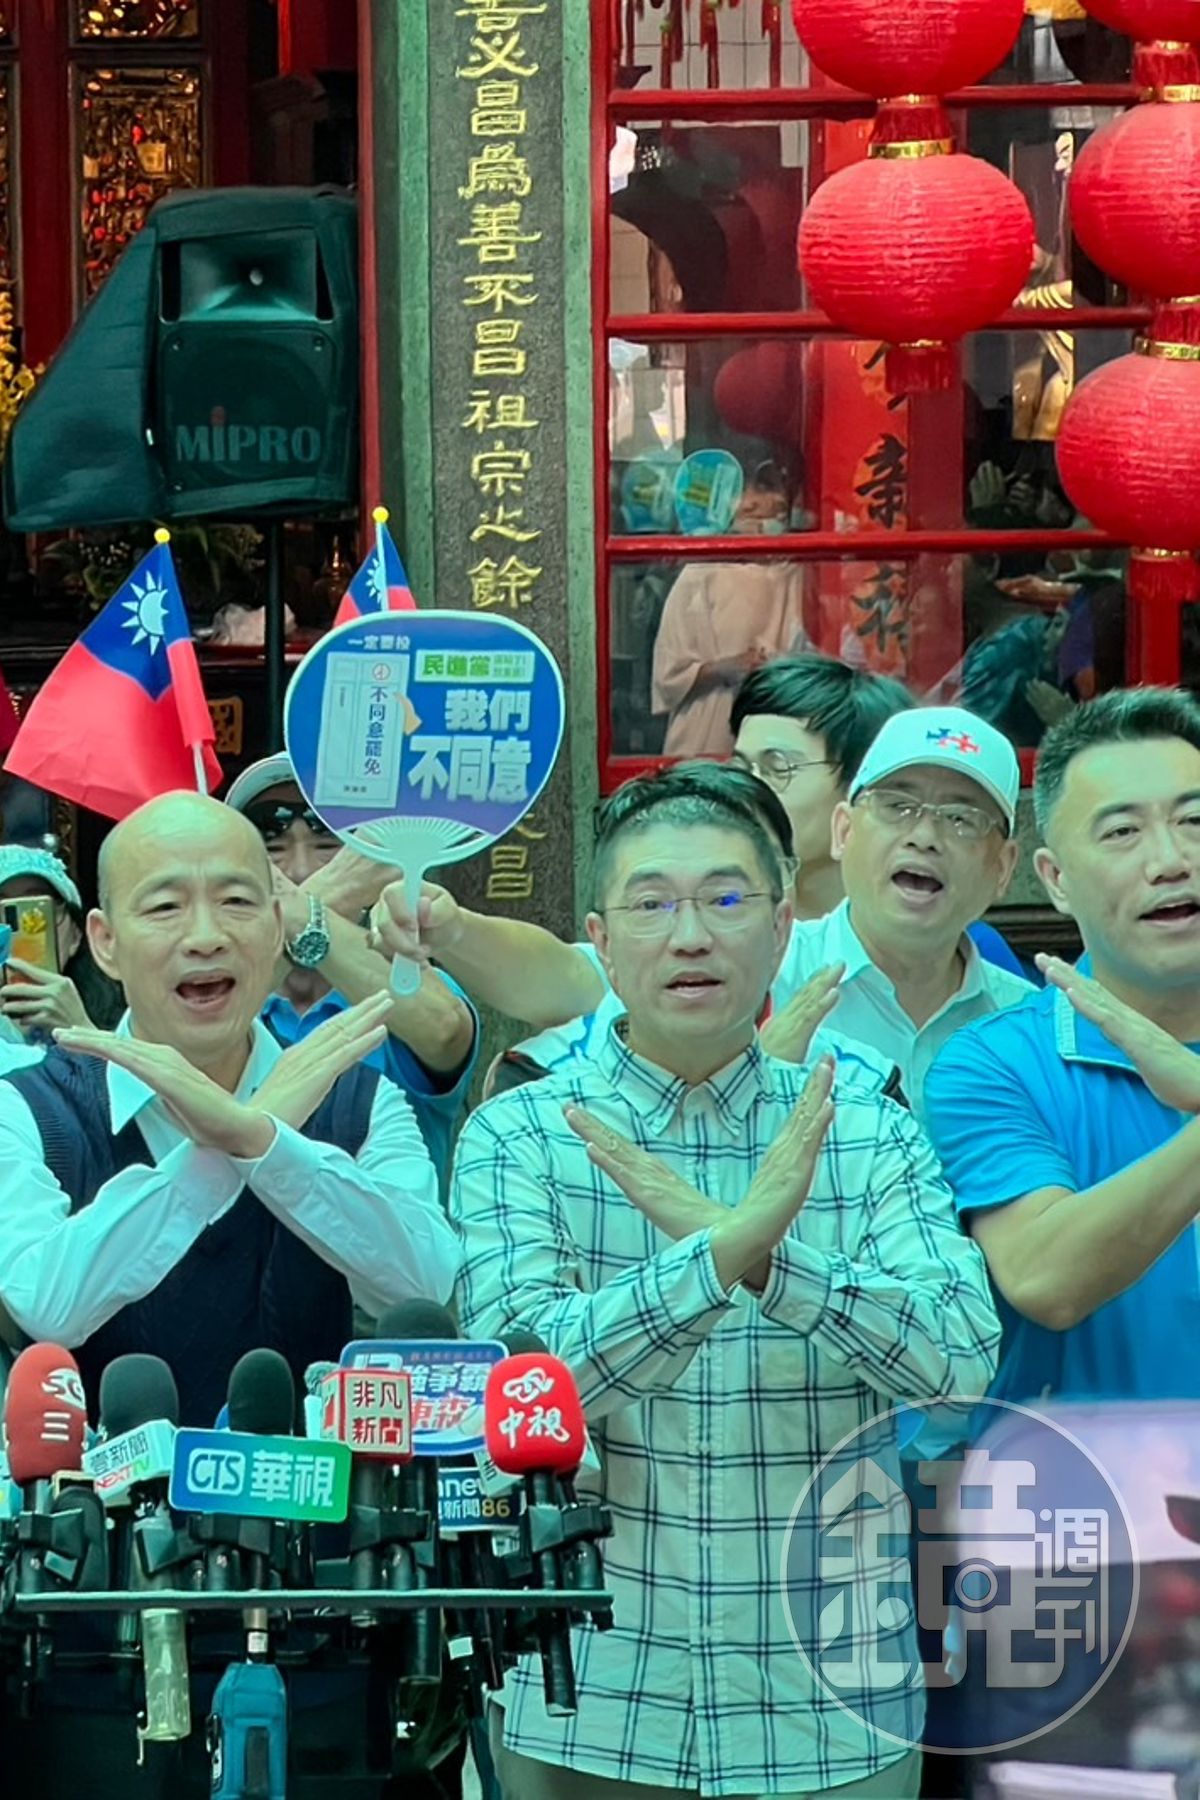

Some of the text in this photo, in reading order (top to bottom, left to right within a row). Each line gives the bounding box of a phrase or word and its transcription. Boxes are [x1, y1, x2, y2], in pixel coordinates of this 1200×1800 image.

[363, 685, 388, 776] 不同意罷免
[445, 689, 532, 732] 我們
[407, 735, 532, 803] 不同意
[353, 1380, 402, 1410] 非凡
[353, 1416, 403, 1447] 新聞
[499, 1406, 571, 1450] 中視
[191, 1453, 241, 1490] CTS
[250, 1449, 336, 1507] 華視
